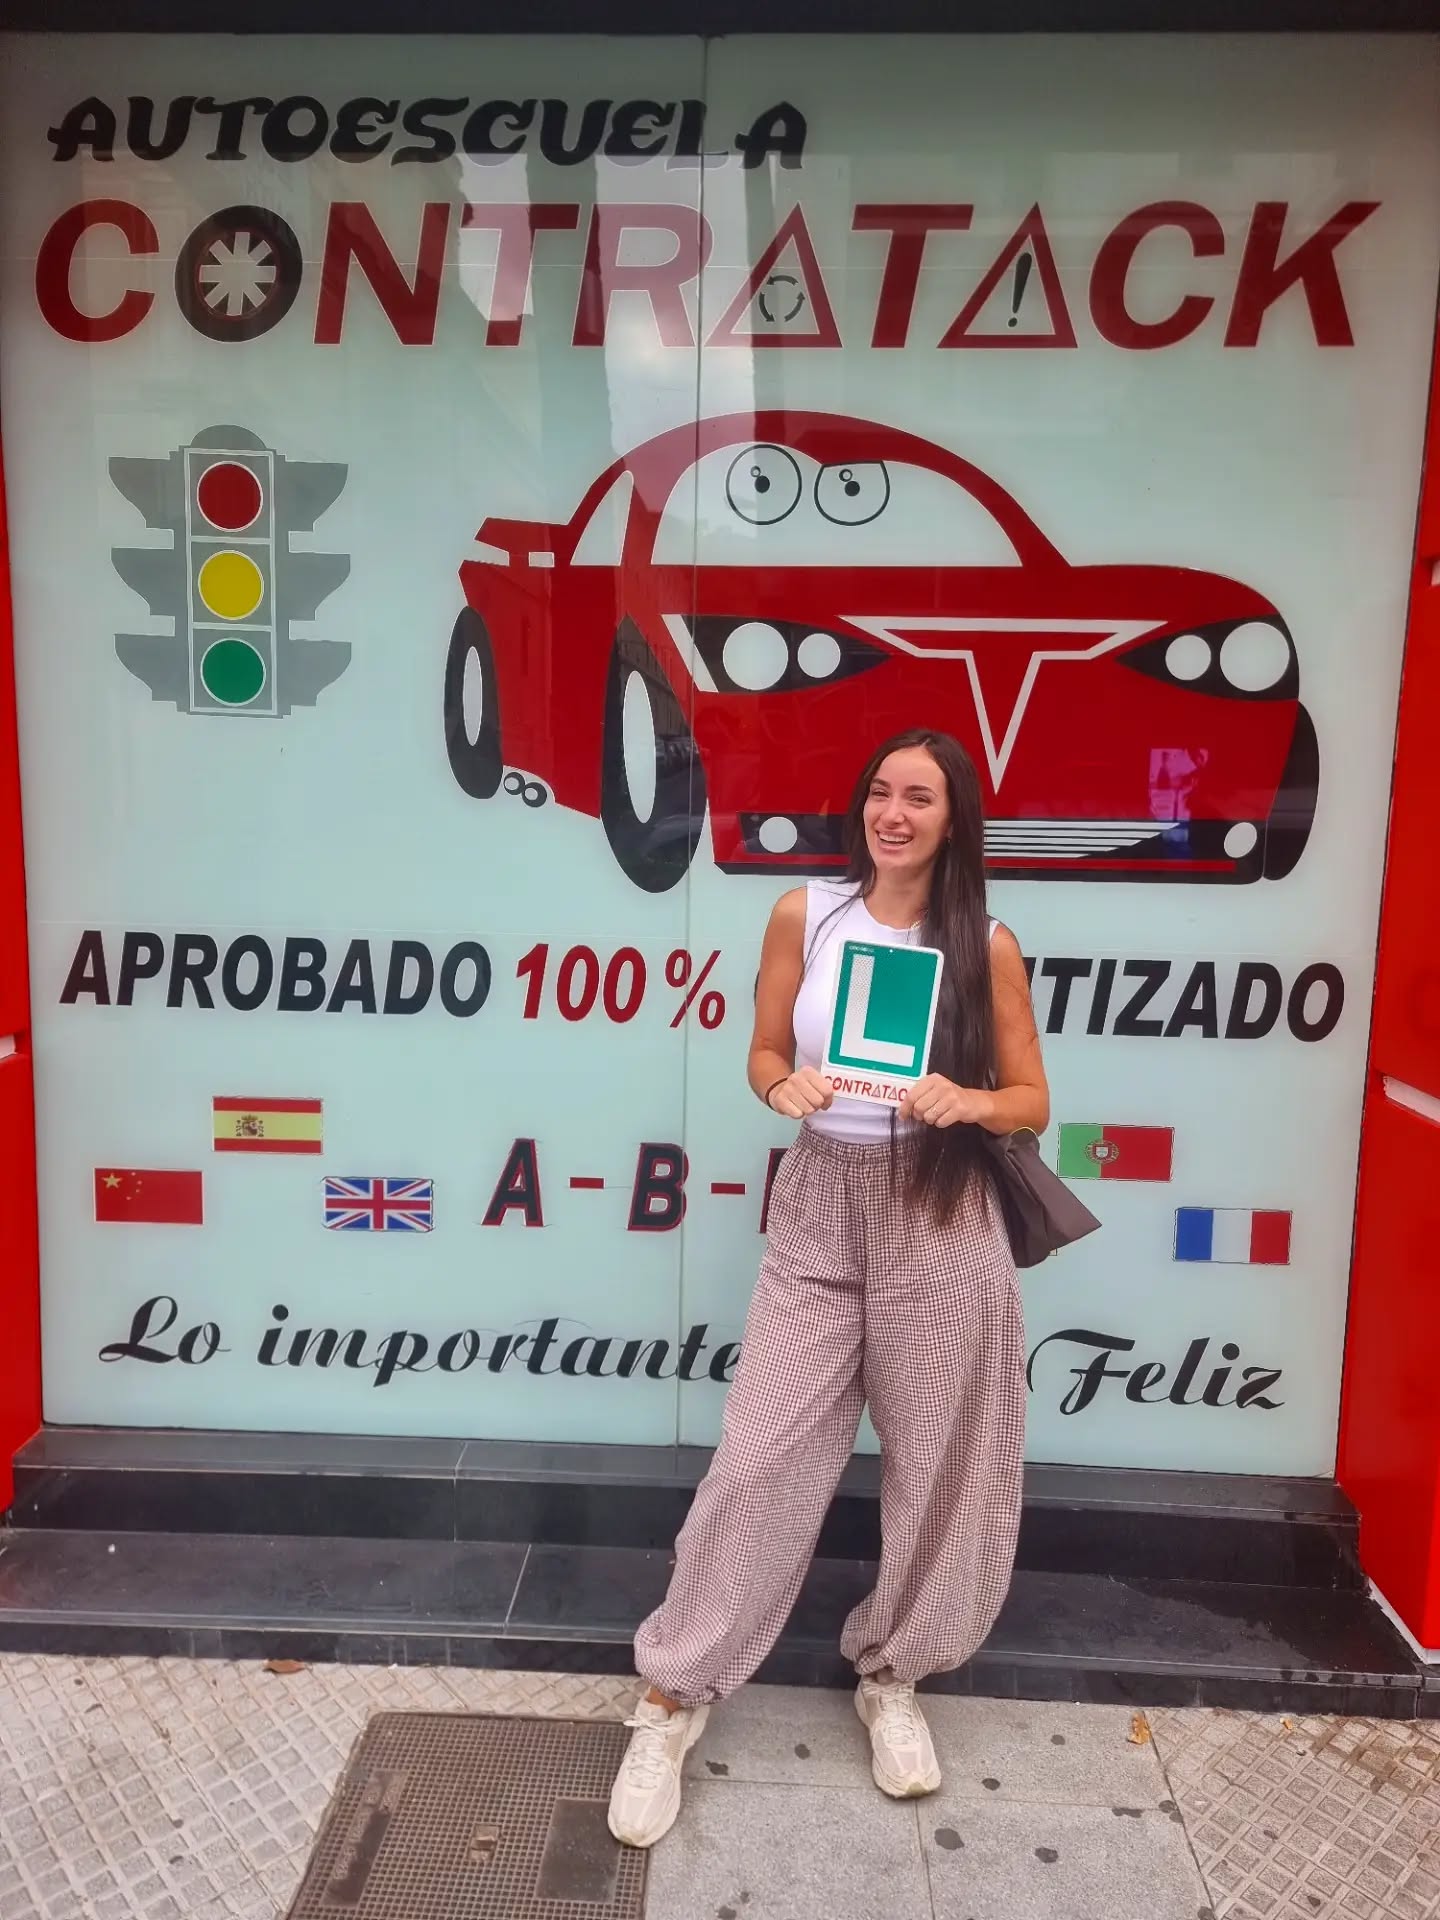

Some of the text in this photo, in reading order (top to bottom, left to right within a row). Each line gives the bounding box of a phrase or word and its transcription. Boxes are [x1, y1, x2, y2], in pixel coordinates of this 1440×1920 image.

[47, 95, 808, 170] AUTOESCUELA
[35, 197, 1383, 350] CONTRATACK
[59, 930, 492, 1018] APROBADO
[515, 943, 647, 1024] 100
[839, 953, 916, 1068] L
[99, 1295, 1285, 1415] Lo importante Feliz
